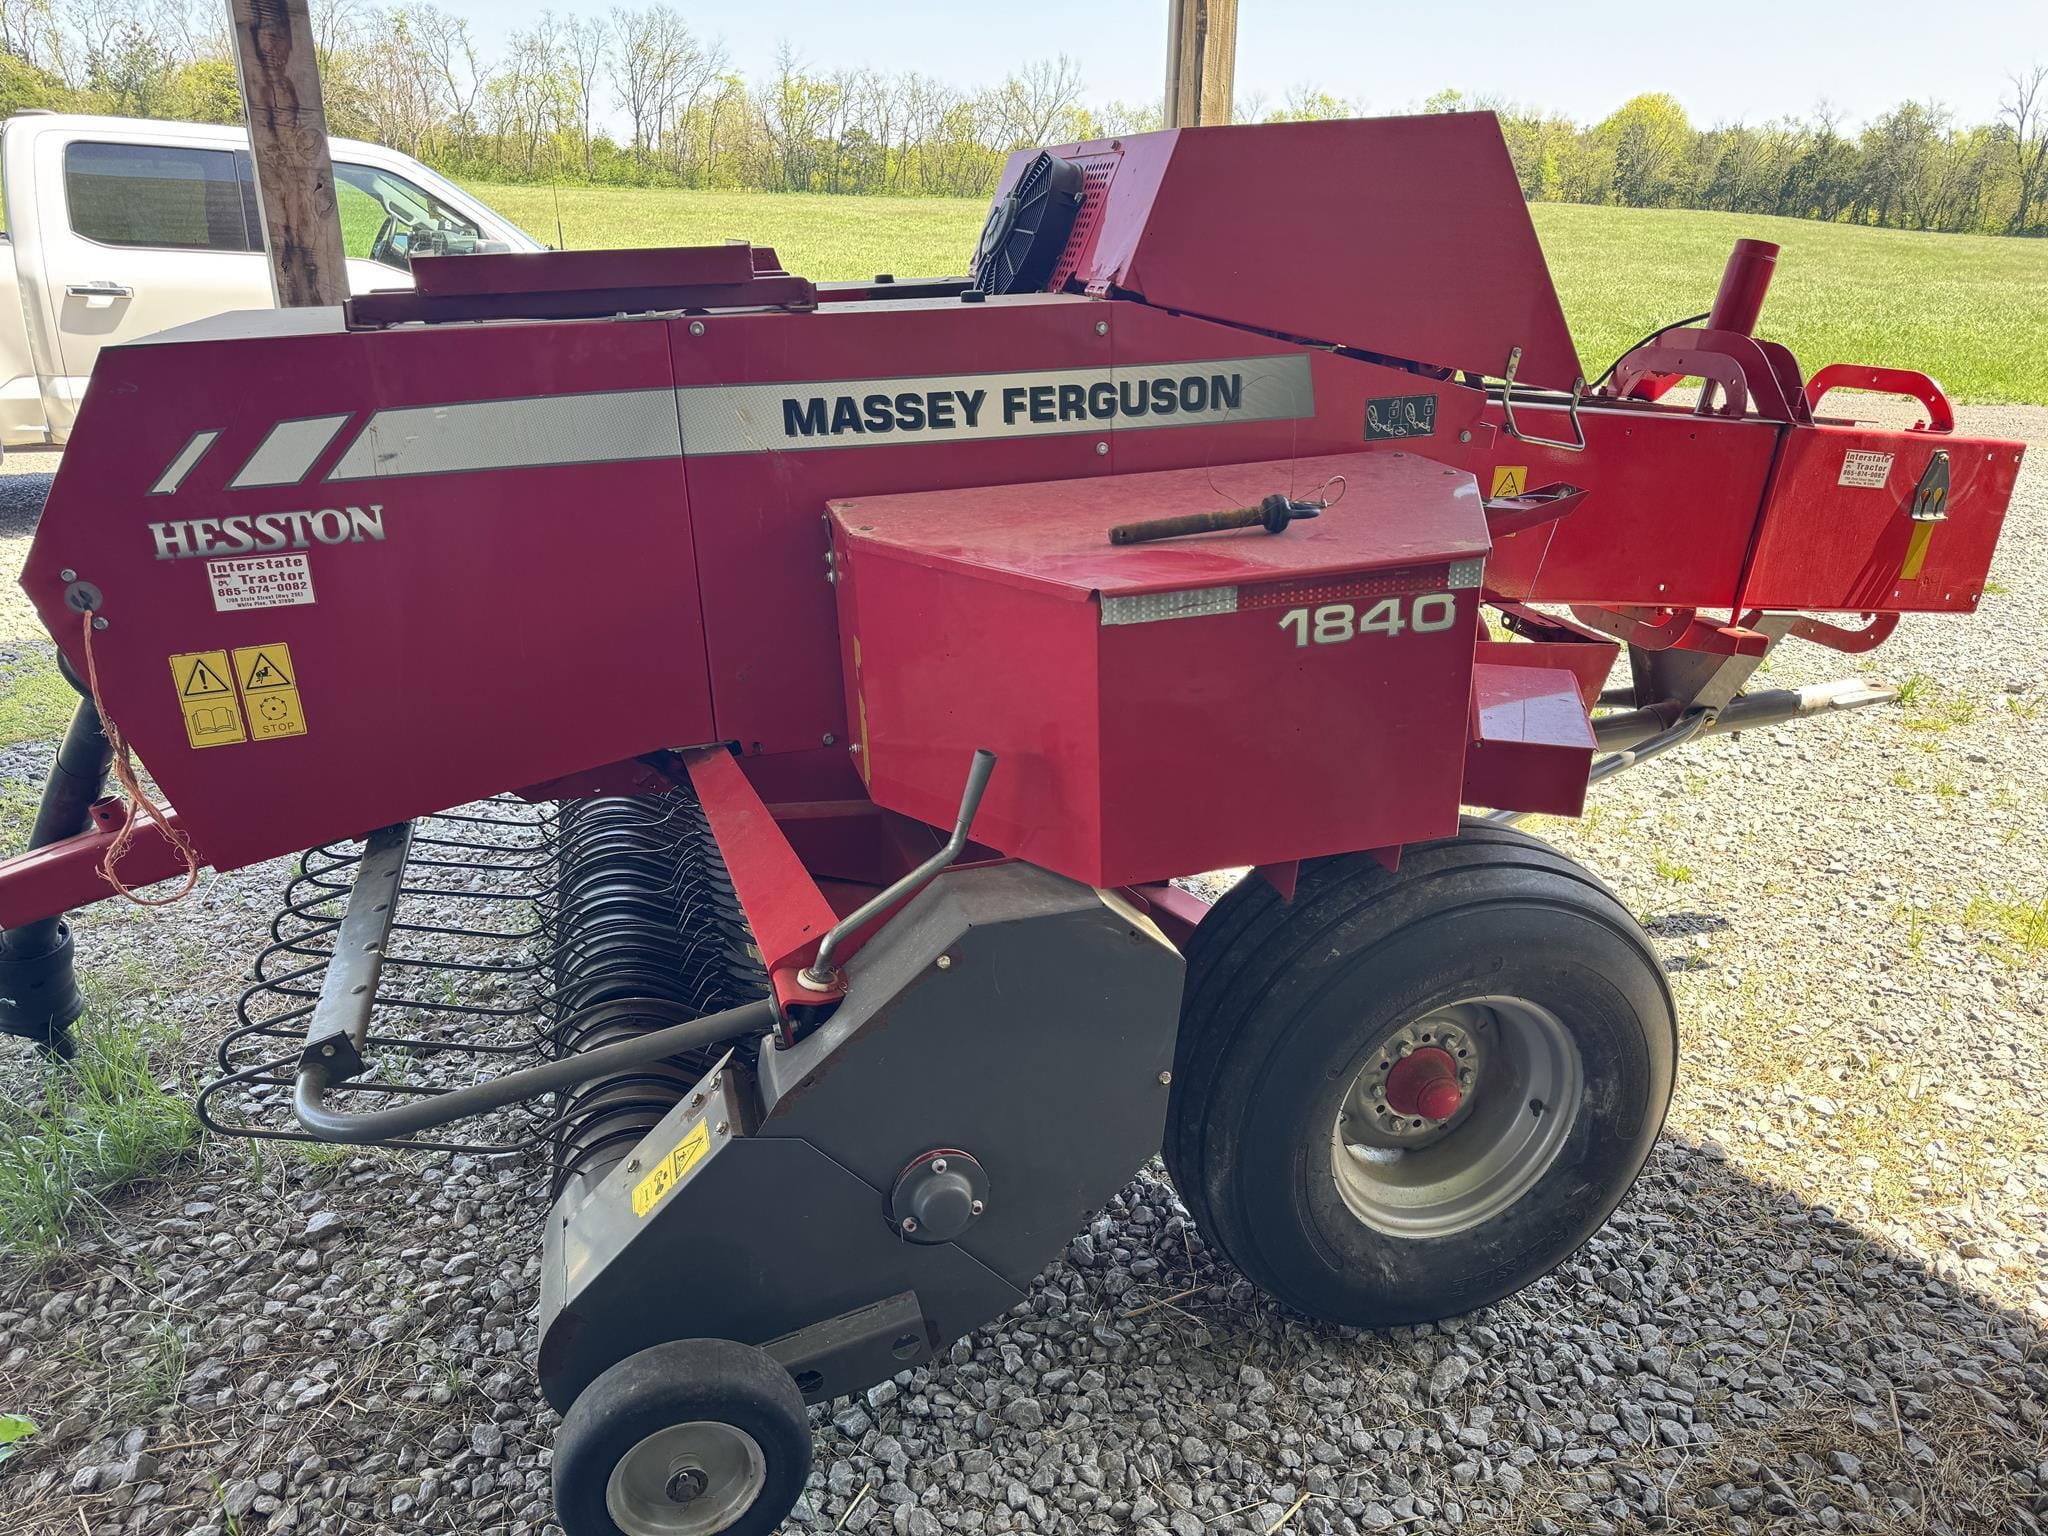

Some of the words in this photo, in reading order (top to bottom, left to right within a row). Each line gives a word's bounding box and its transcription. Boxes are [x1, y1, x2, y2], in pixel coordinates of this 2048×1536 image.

[781, 388, 988, 437] MASSEY
[1001, 373, 1243, 425] FERGUSON
[1846, 452, 1890, 463] Interstate
[1856, 462, 1887, 472] Tractor
[147, 504, 387, 560] HESSTON
[210, 558, 303, 573] Interstate
[238, 571, 305, 585] Tractor
[218, 581, 308, 597] 865-674-0082
[1277, 592, 1456, 648] 1840
[262, 721, 295, 734] STOP
